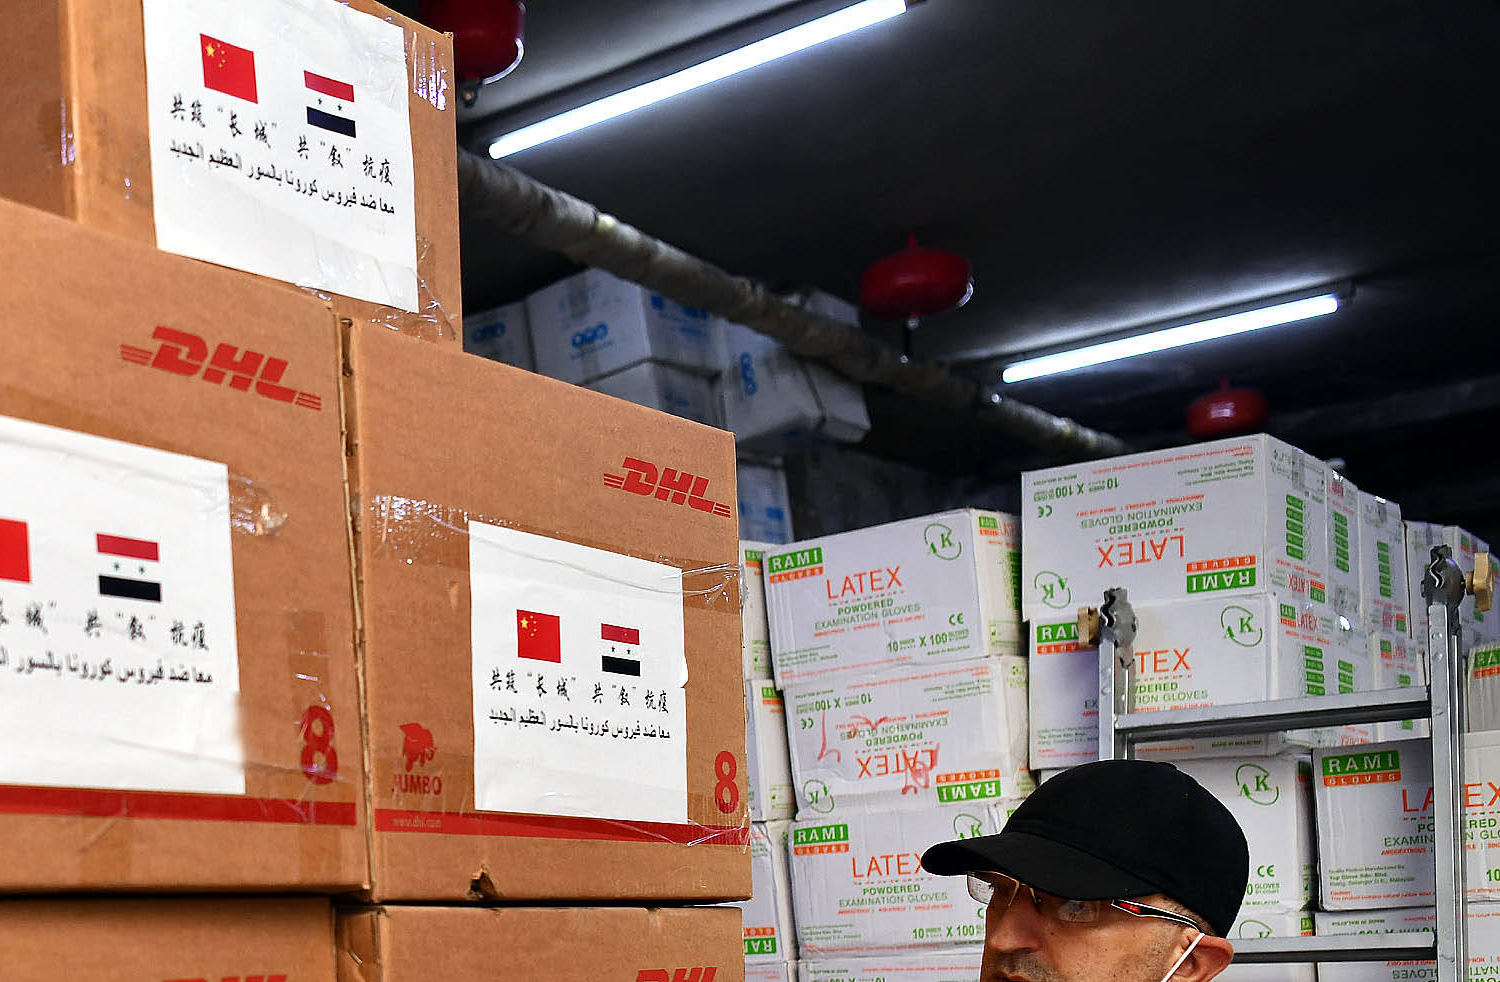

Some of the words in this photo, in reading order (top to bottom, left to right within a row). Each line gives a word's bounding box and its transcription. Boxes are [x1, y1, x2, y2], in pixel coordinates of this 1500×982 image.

[170, 140, 204, 163] الجديد
[209, 147, 242, 170] العظيم
[285, 170, 318, 197] كورونا
[322, 186, 357, 208] فيروس
[151, 325, 297, 403] DHL
[621, 456, 714, 513] DHL
[1081, 515, 1124, 529] GLOVES
[1127, 502, 1203, 522] EXAMINATION
[1109, 517, 1173, 535] POWDERED
[771, 550, 819, 571] RAMI
[1097, 535, 1185, 569] LATEX
[826, 565, 904, 600] LATEX
[1191, 570, 1250, 590] RAMI
[815, 612, 878, 632] EXAMINATION
[881, 603, 921, 618] GLOVES
[838, 598, 894, 616] POWDERED
[1042, 624, 1080, 641] RAM
[1134, 648, 1191, 675] TEX
[300, 705, 338, 786] 8
[866, 732, 924, 747] POWDERED
[857, 748, 936, 779] LATEX
[1329, 753, 1395, 773] RAMI
[714, 750, 739, 814] 8
[1329, 773, 1396, 785] GLOVES
[942, 781, 997, 801] RAMI
[797, 825, 847, 843] RAMI
[839, 896, 905, 909] EXAMINATION
[907, 892, 948, 904] GLOVES
[863, 884, 921, 896] POWDERED
